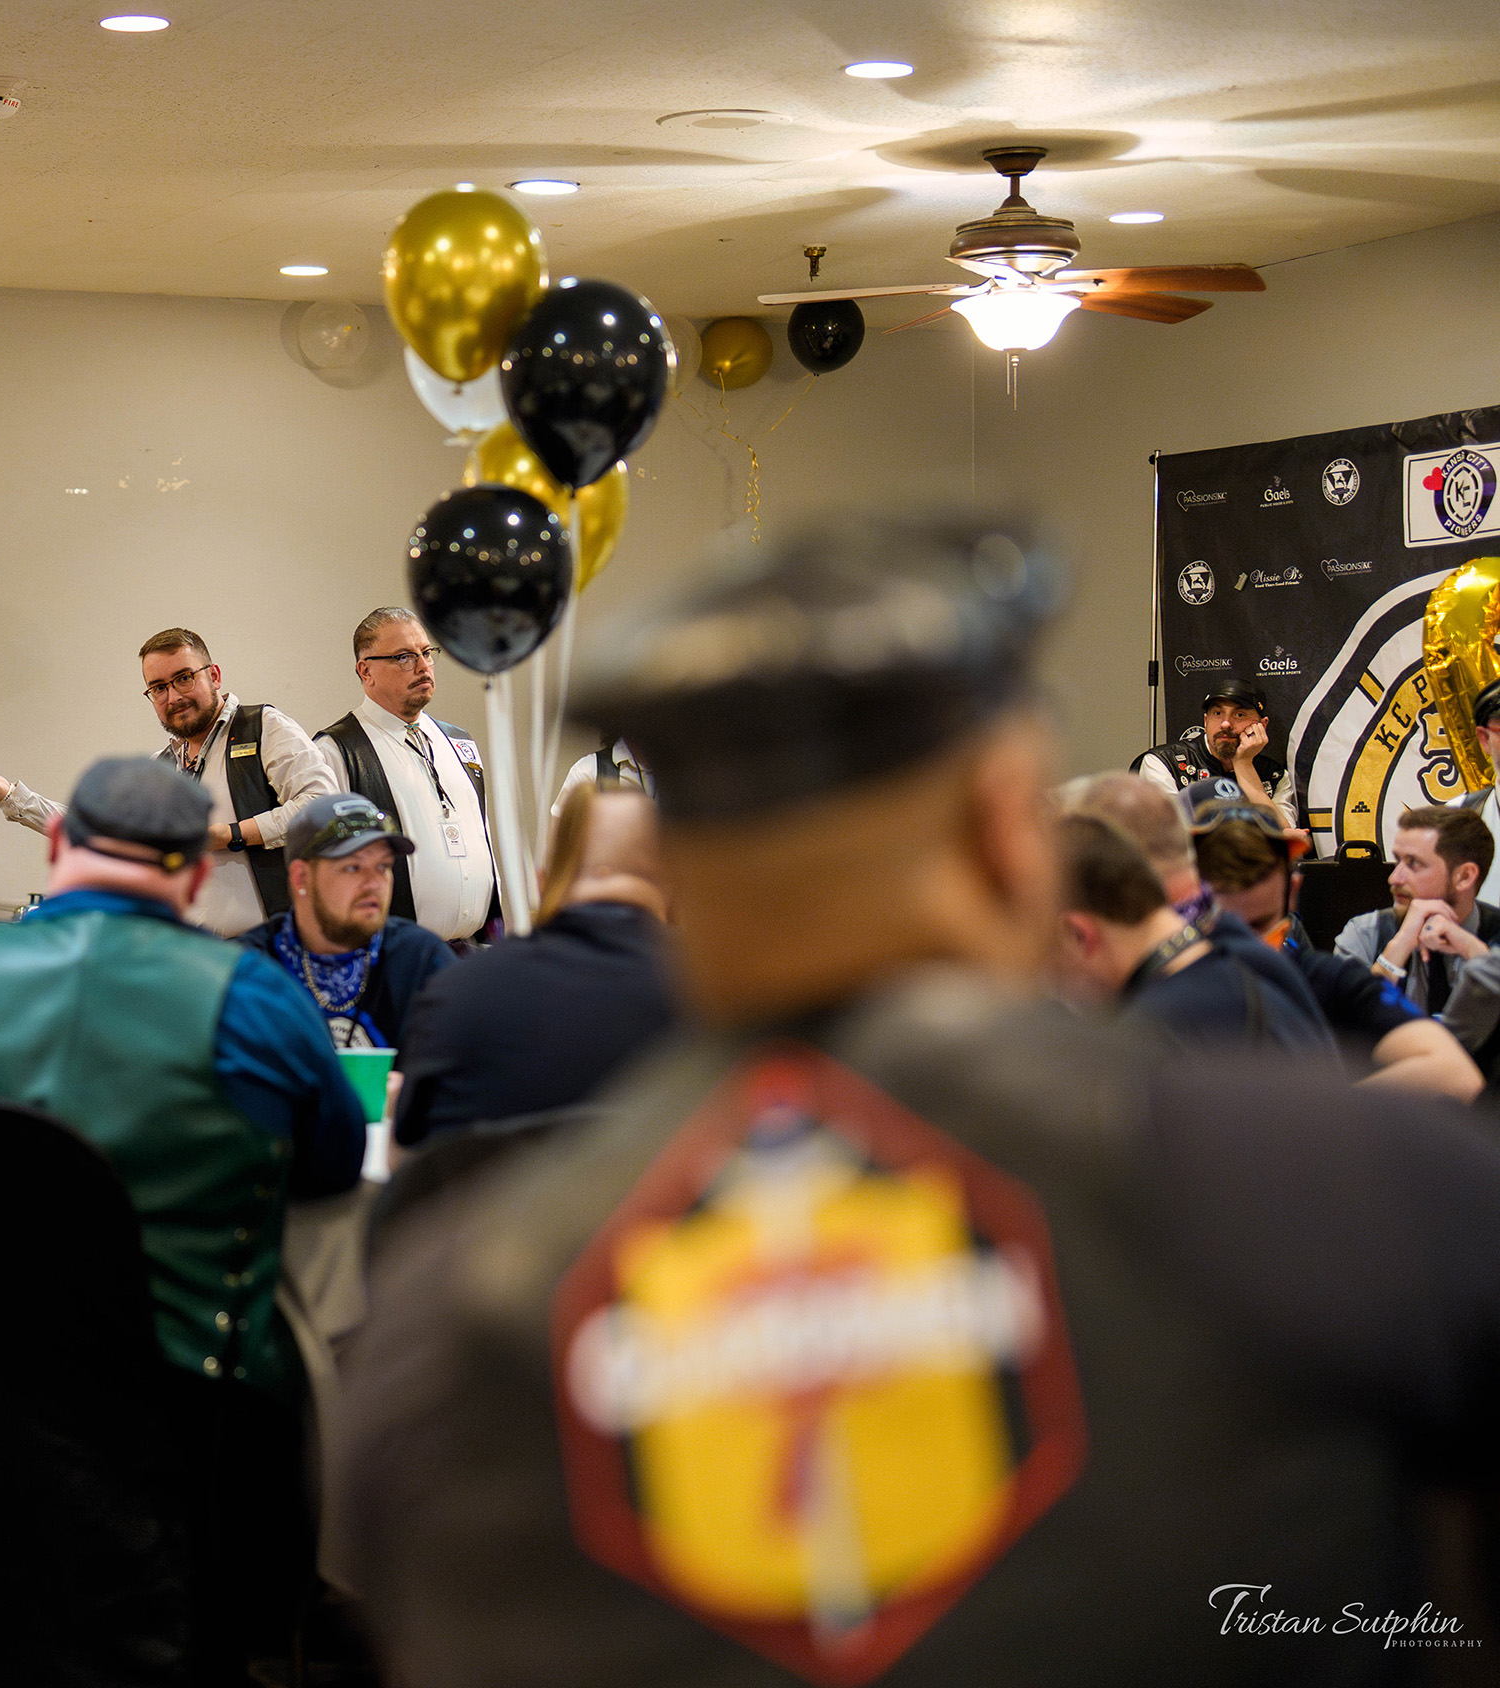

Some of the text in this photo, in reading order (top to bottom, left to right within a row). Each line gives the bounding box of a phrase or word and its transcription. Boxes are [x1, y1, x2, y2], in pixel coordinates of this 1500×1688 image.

[1466, 453, 1490, 470] CITY
[1264, 487, 1291, 502] Gaels
[1259, 657, 1298, 671] Gaels
